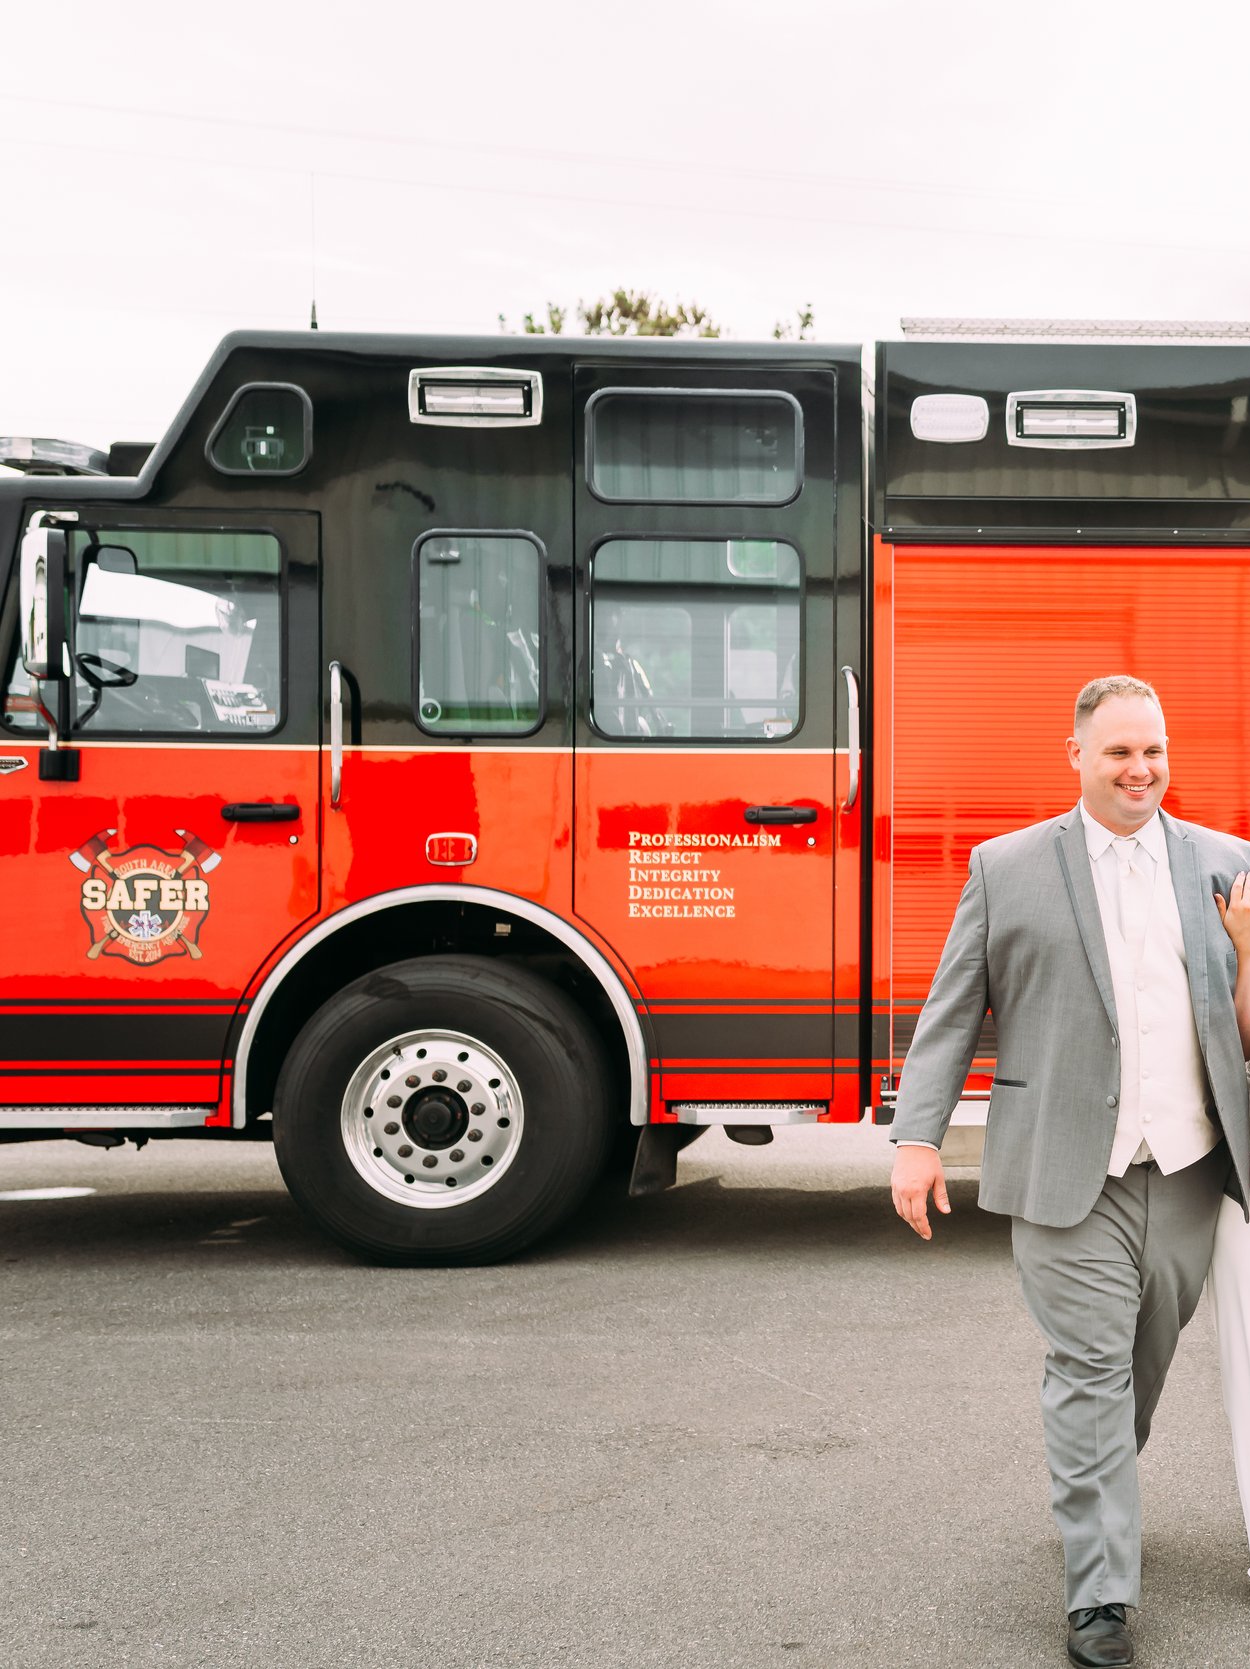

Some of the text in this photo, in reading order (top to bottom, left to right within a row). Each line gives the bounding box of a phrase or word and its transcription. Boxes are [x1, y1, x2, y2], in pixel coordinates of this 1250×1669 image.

[628, 831, 782, 847] PROFESSIONALISM
[628, 849, 702, 864] RESPECT
[114, 858, 176, 879] SOUTH AREA
[628, 867, 721, 882] INTEGRITY
[82, 878, 209, 911] SAFER
[628, 885, 735, 900] DEDICATION
[628, 903, 736, 918] EXCELLENCE
